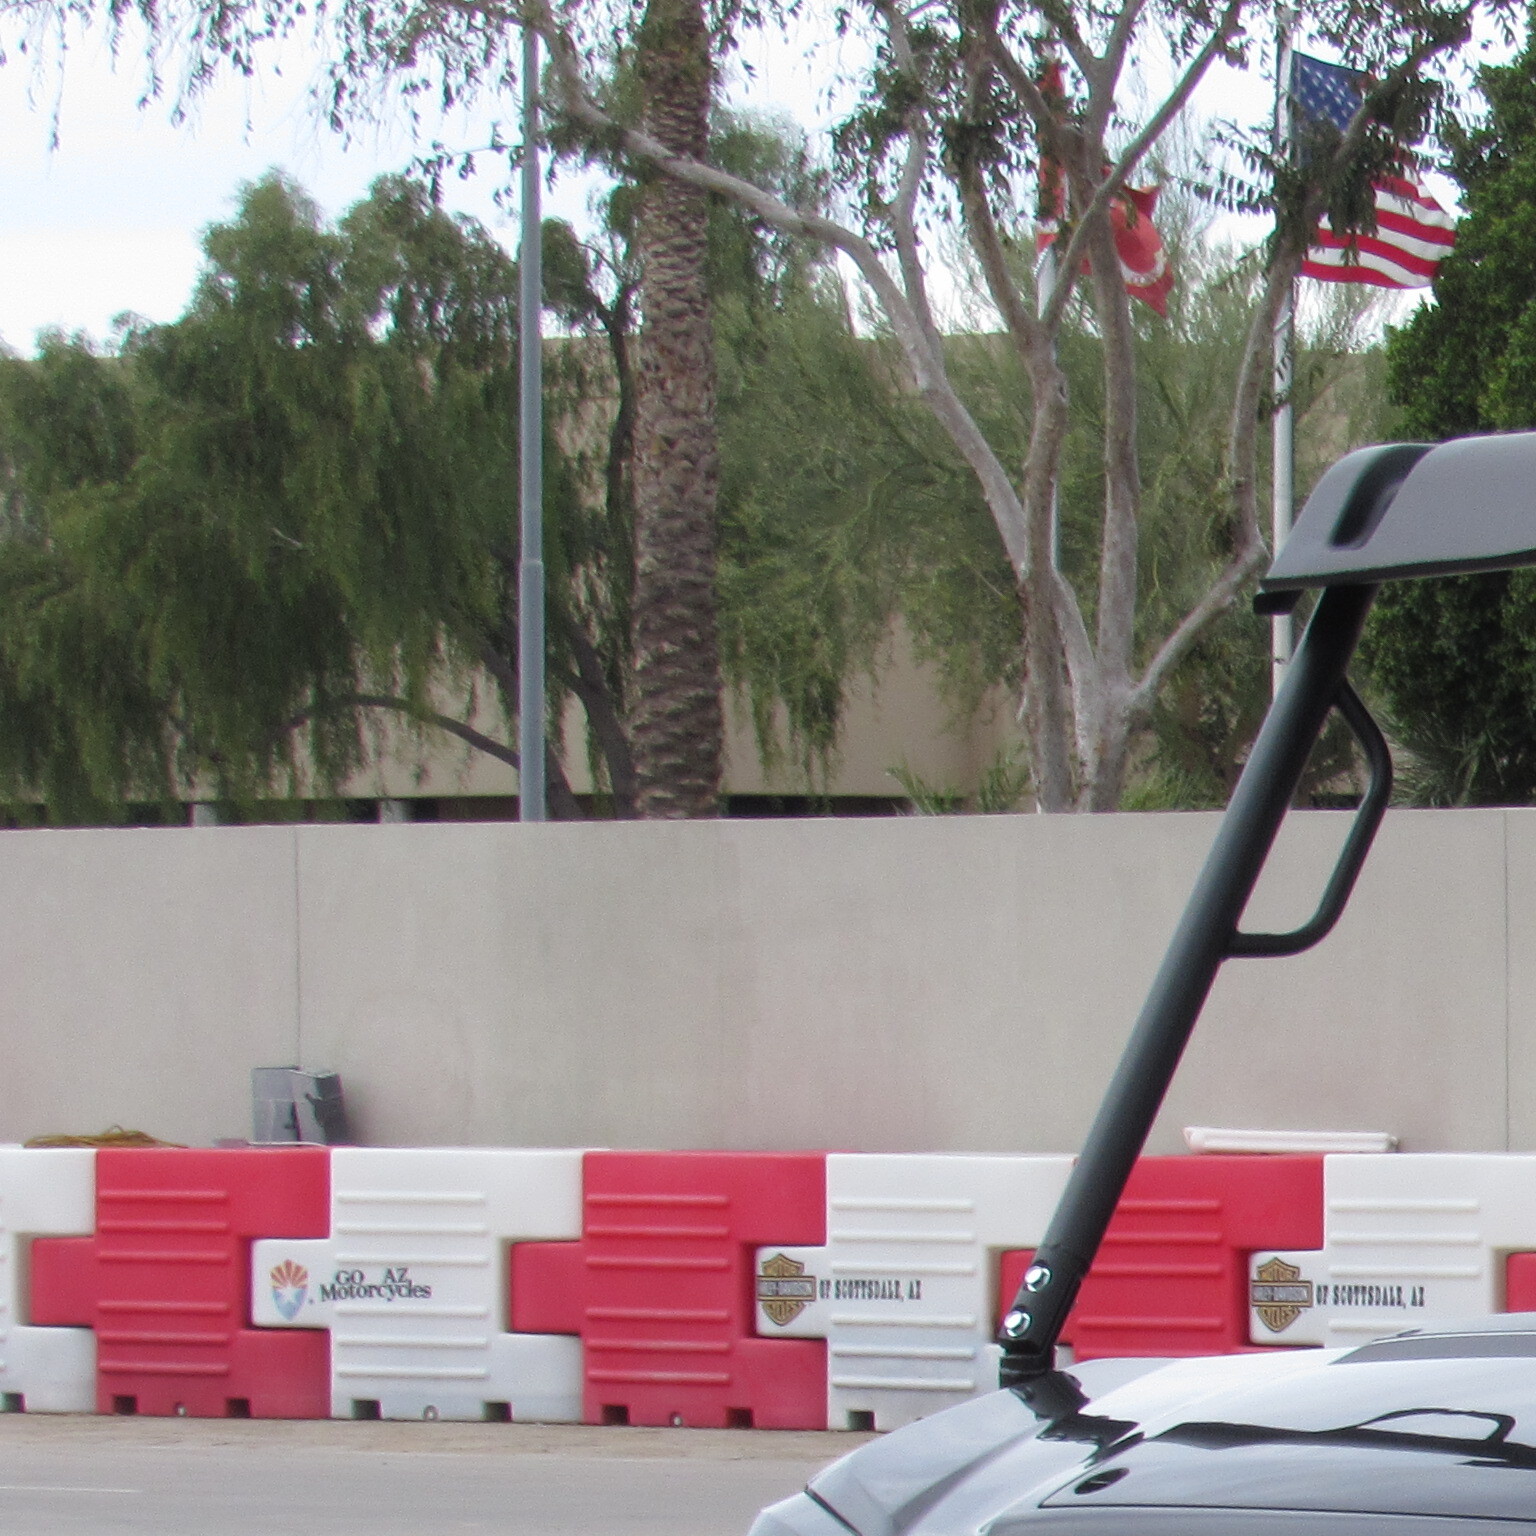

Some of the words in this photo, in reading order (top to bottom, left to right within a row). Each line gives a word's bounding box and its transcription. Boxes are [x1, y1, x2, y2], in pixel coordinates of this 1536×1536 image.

[335, 1269, 366, 1286] GO
[384, 1267, 409, 1284] AZ
[320, 1279, 432, 1302] Motorcycles
[1316, 1285, 1329, 1305] OF
